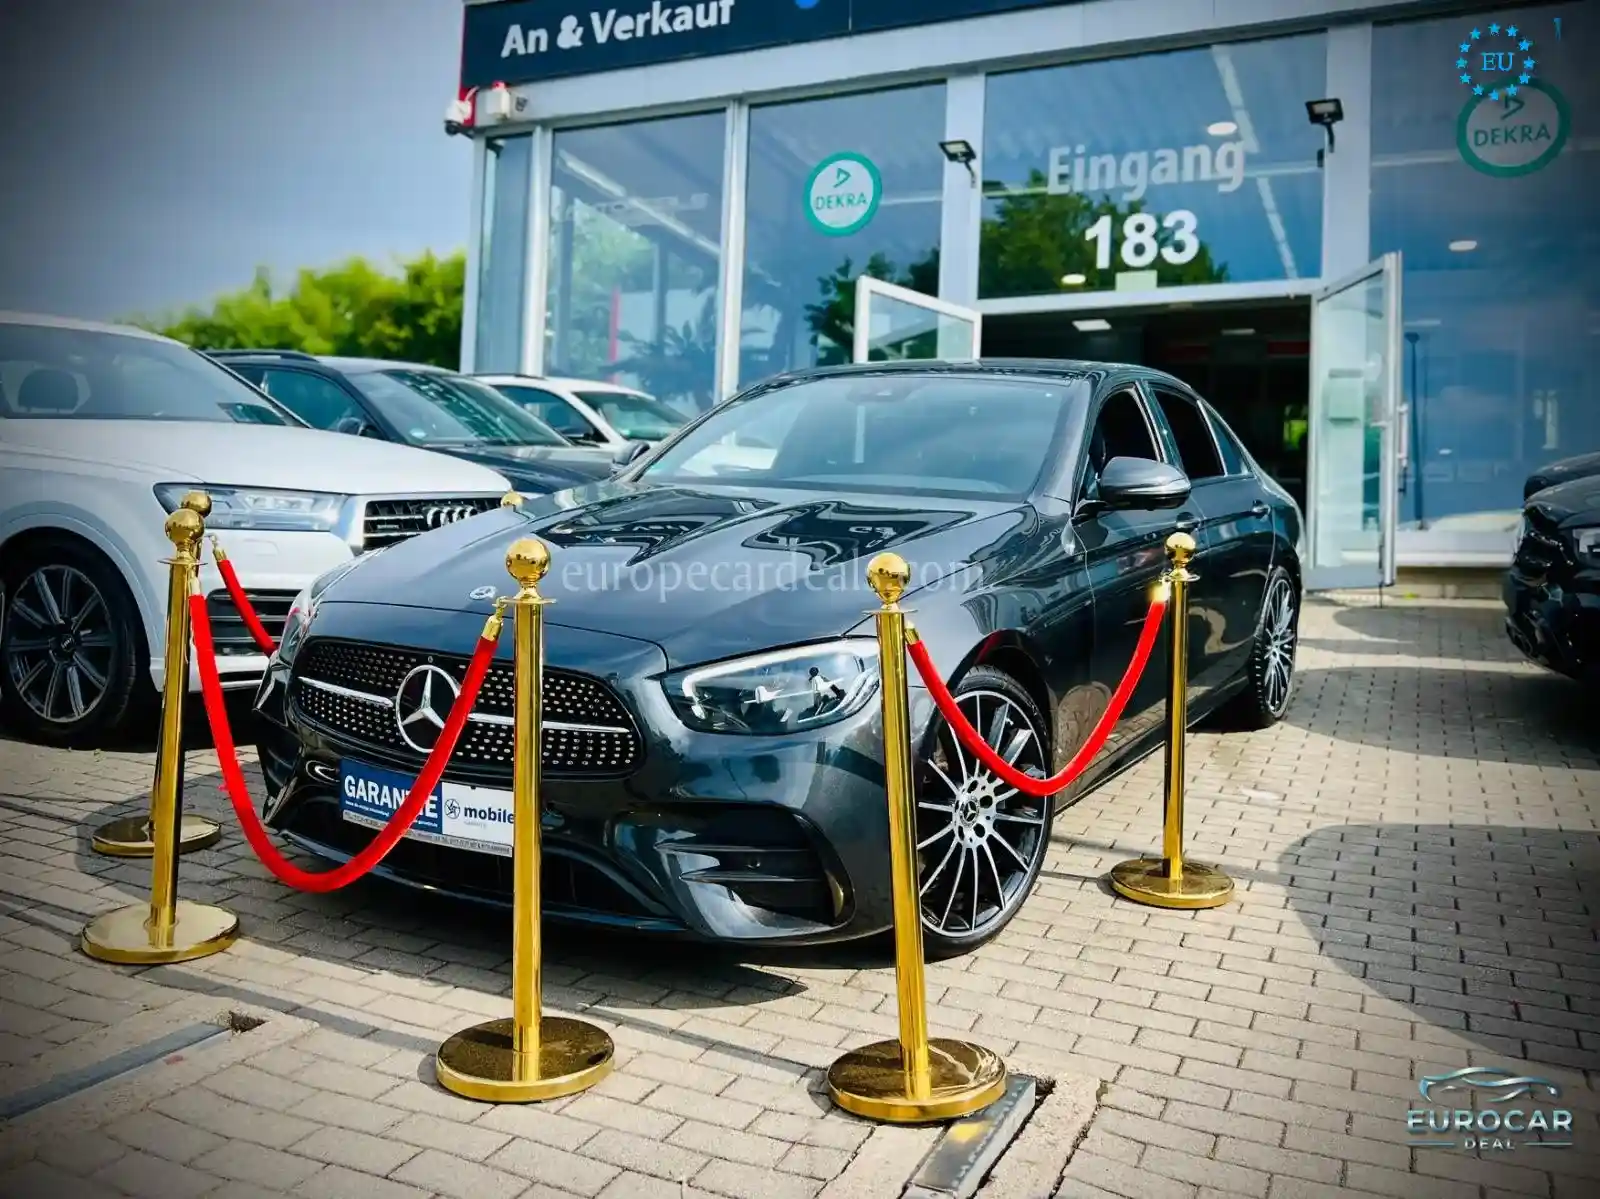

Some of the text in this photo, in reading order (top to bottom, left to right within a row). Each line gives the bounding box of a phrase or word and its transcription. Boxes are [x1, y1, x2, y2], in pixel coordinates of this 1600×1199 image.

[501, 0, 734, 58] An & Verkauf
[1474, 123, 1551, 147] DEKRA
[1047, 140, 1245, 201] Eingang
[815, 191, 868, 210] DEKRA
[1085, 209, 1200, 269] 183
[344, 774, 438, 819] GARANE
